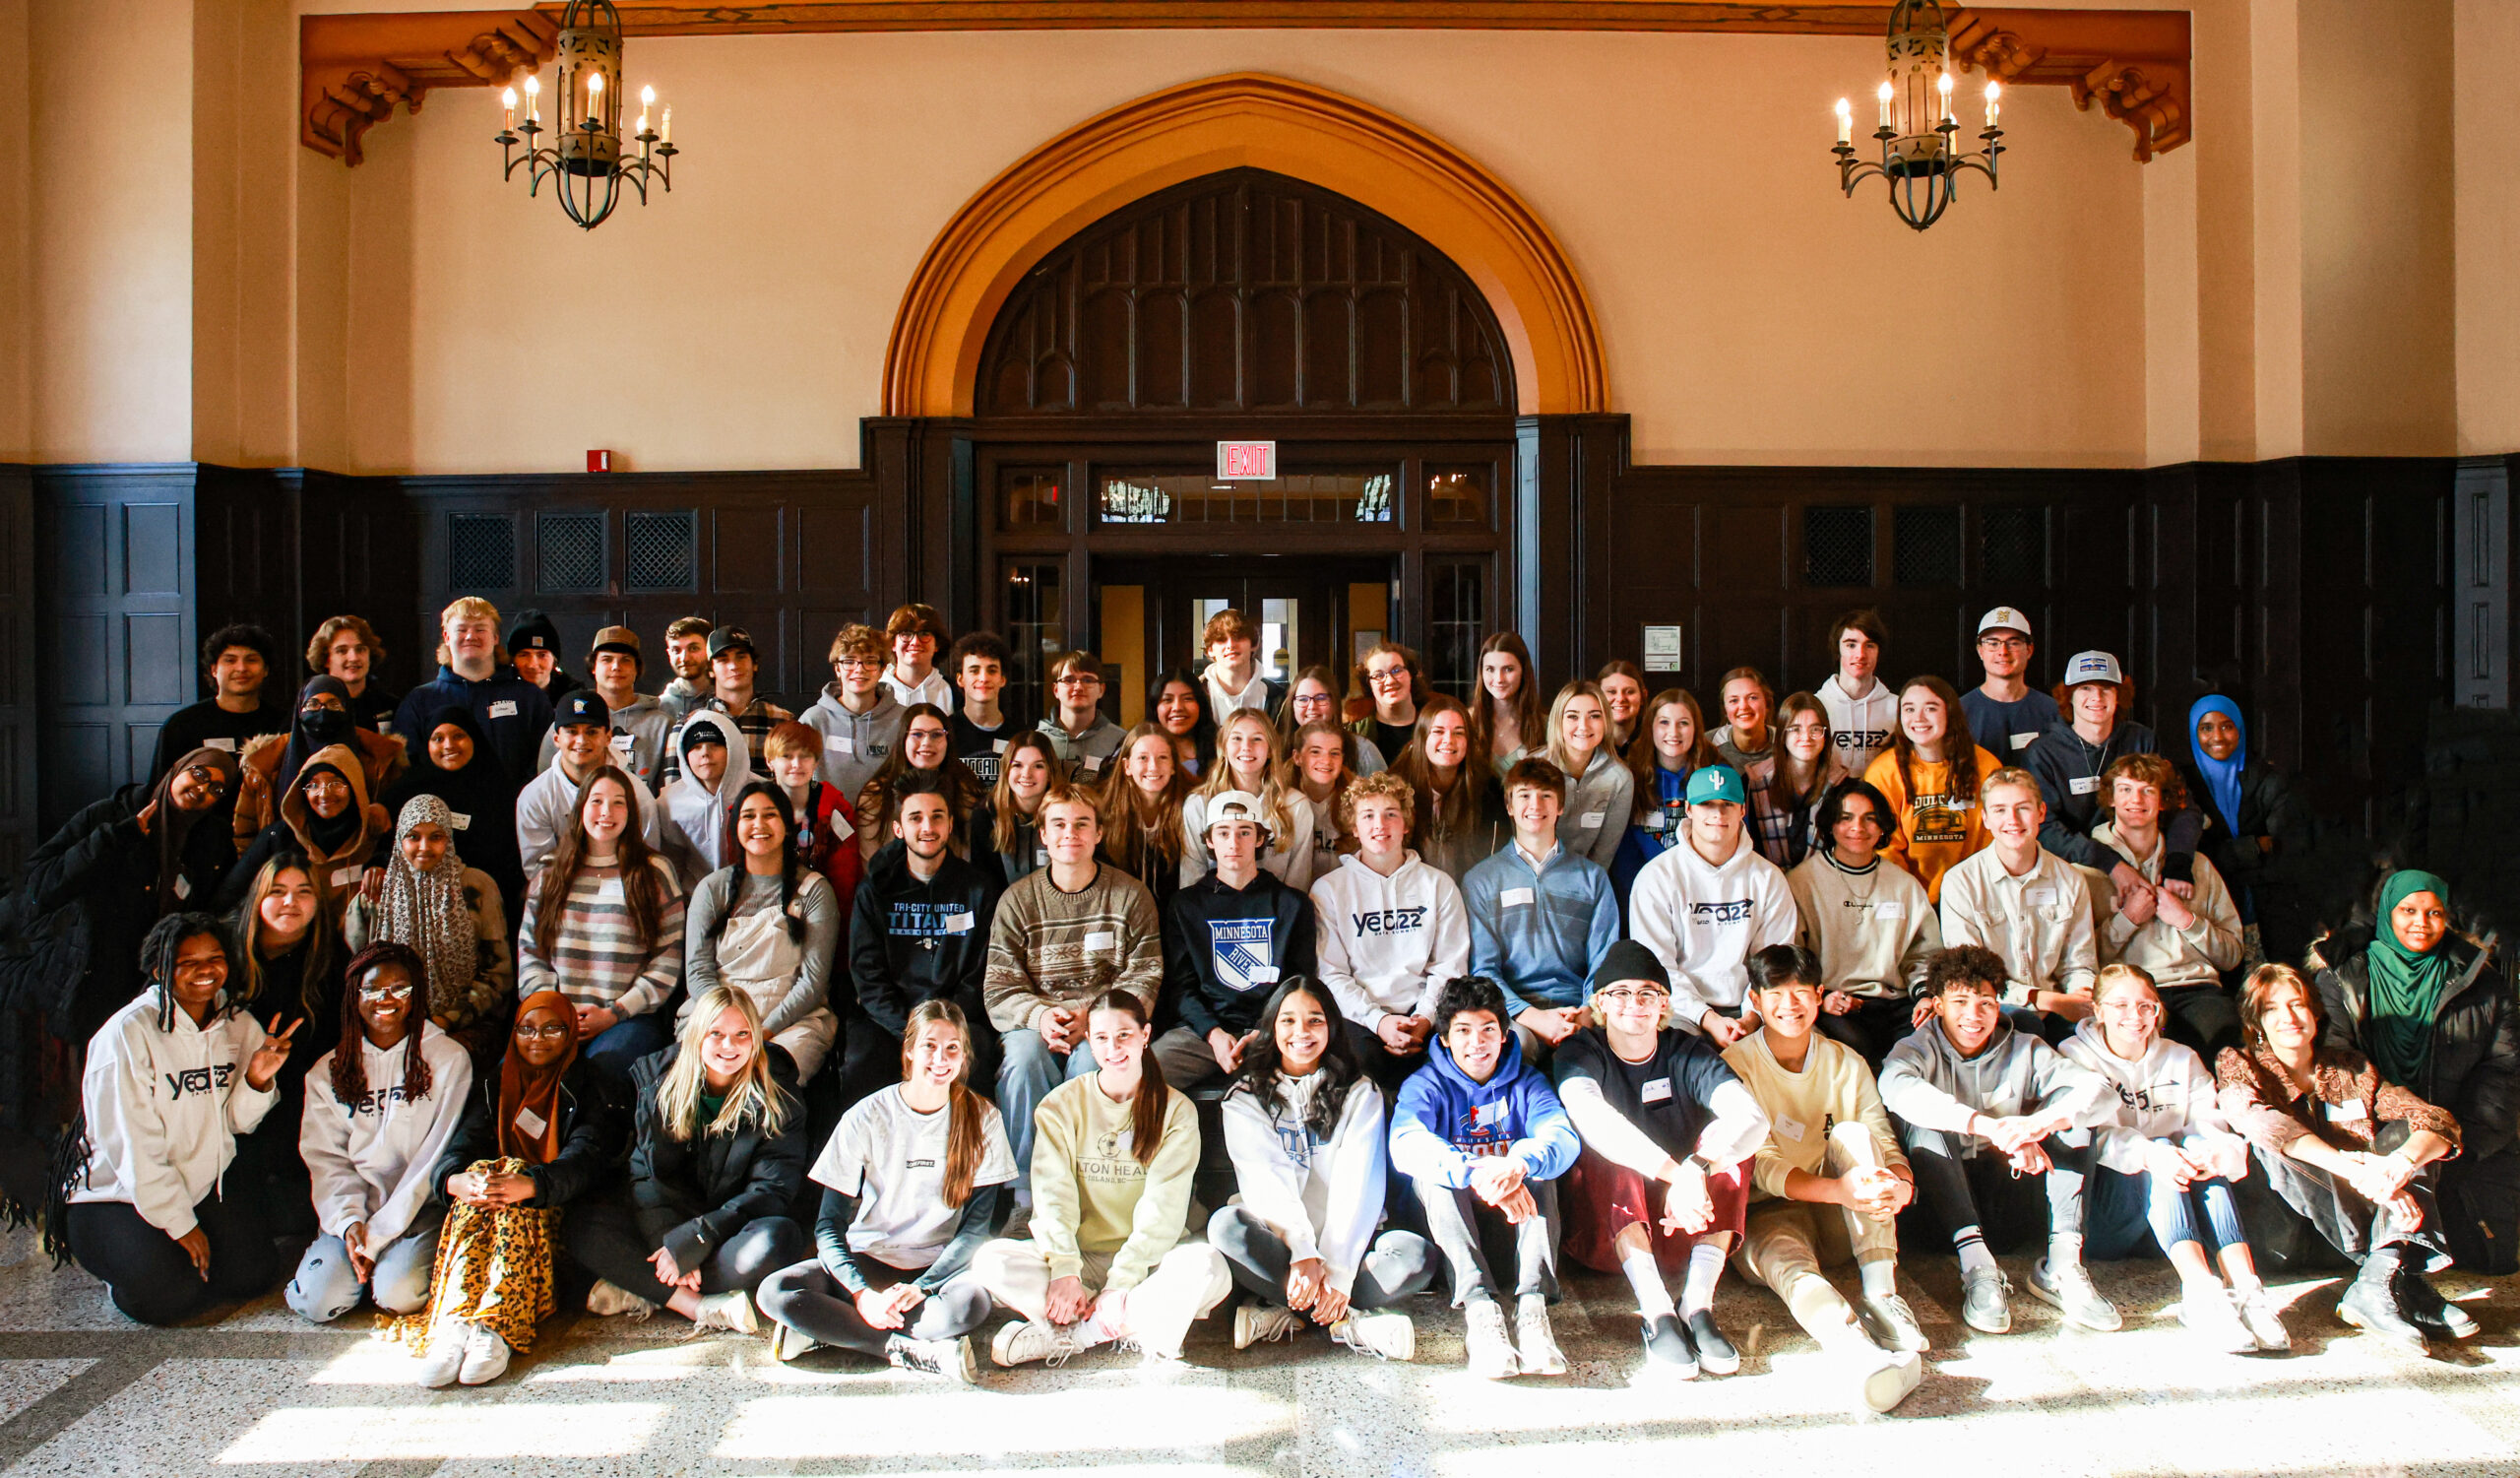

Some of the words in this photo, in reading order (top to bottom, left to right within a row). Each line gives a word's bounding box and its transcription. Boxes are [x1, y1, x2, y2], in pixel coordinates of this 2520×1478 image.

[1228, 445, 1269, 476] EXIT
[894, 902, 931, 913] TRI-CITY
[934, 903, 965, 913] UNITED
[1215, 926, 1268, 939] MINNESOTA
